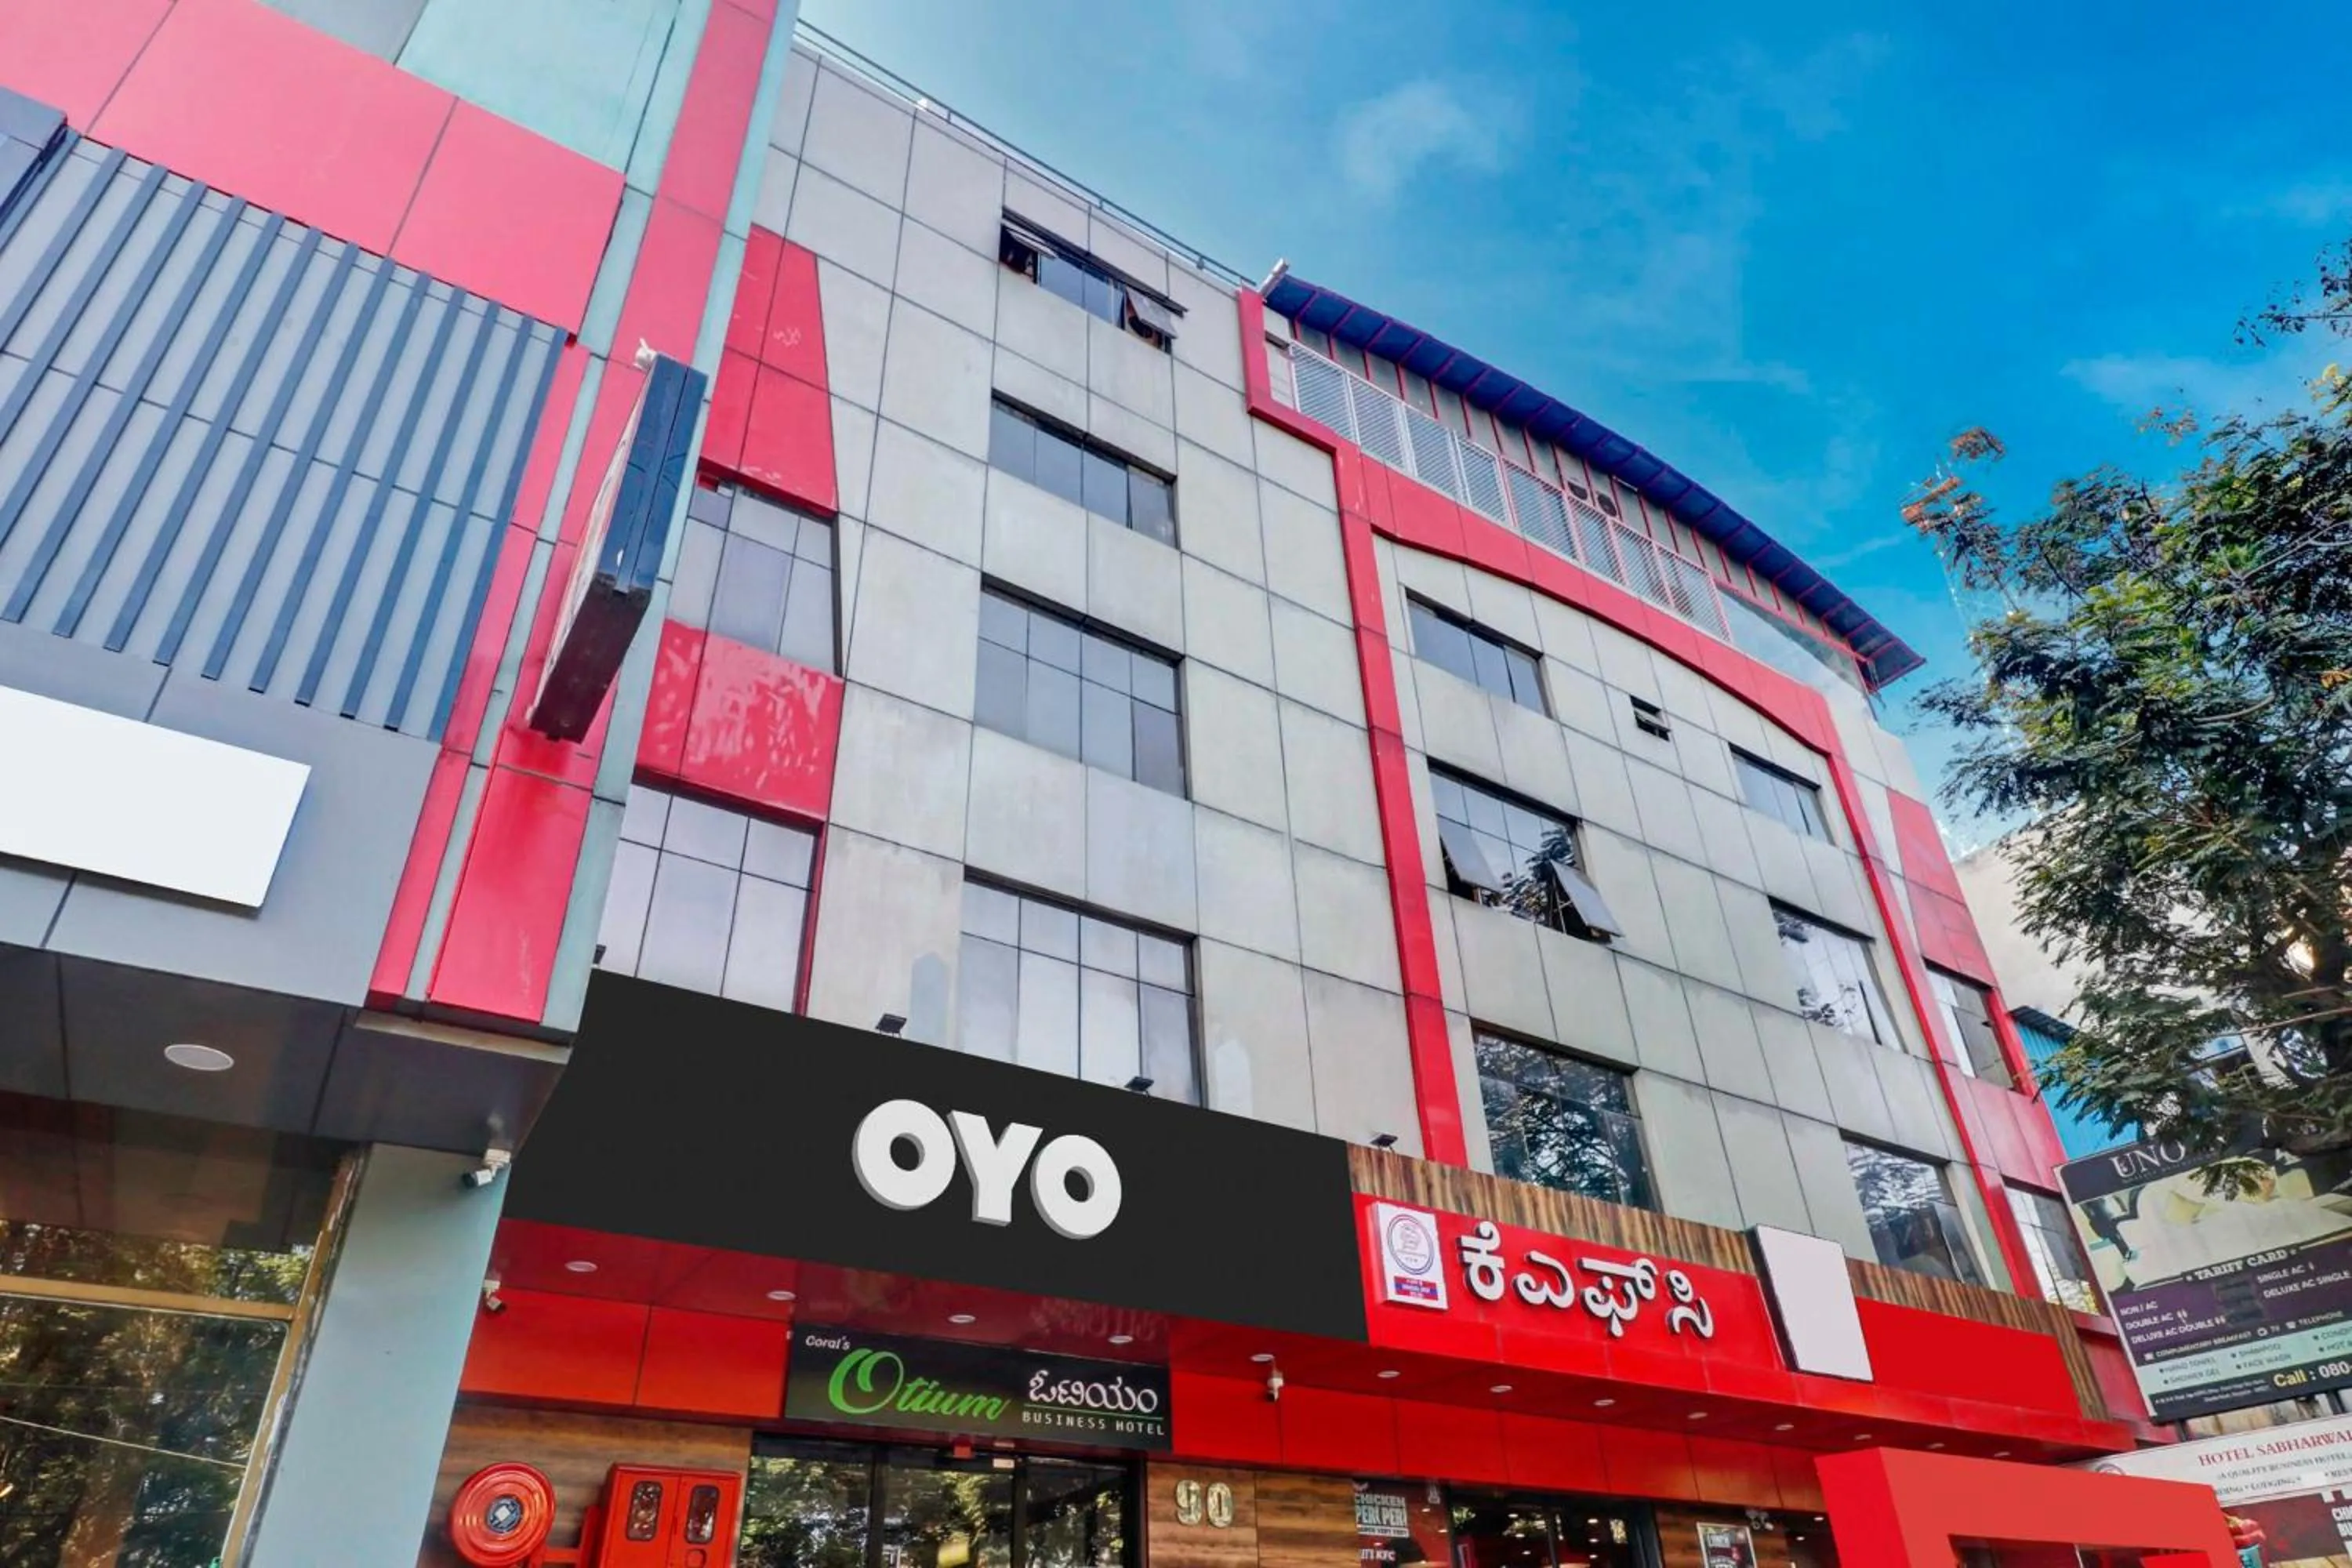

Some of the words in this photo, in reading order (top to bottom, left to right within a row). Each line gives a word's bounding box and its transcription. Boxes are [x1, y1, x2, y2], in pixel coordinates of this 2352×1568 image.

[2109, 1139, 2186, 1178] UNO
[852, 1098, 1123, 1240] OYO
[2195, 1261, 2243, 1280] TARIFF
[2246, 1249, 2288, 1267] CARD
[2257, 1269, 2289, 1283] SINGLE
[2292, 1265, 2305, 1275] AC
[2263, 1283, 2301, 1298] DELUXE
[2302, 1279, 2316, 1288] AC
[2316, 1270, 2352, 1285] SINGLE
[2146, 1301, 2158, 1310] AC
[2125, 1316, 2159, 1330] DOUBLE
[2161, 1312, 2174, 1321] AC
[2165, 1327, 2178, 1336] AC
[2179, 1319, 2215, 1334] DOUBLE
[805, 1334, 851, 1351] Coral's
[828, 1347, 1013, 1421] Otium
[2274, 1369, 2307, 1387] Call
[1022, 1410, 1107, 1431] BUSINESS
[1116, 1420, 1165, 1436] HOTEL
[2198, 1447, 2255, 1466] HOTEL
[1176, 1479, 1233, 1528] 90
[1355, 1493, 1406, 1507] CHICKEN
[1356, 1504, 1381, 1524] PERI
[1381, 1506, 1408, 1526] PERI
[1375, 1549, 1396, 1562] KFC
